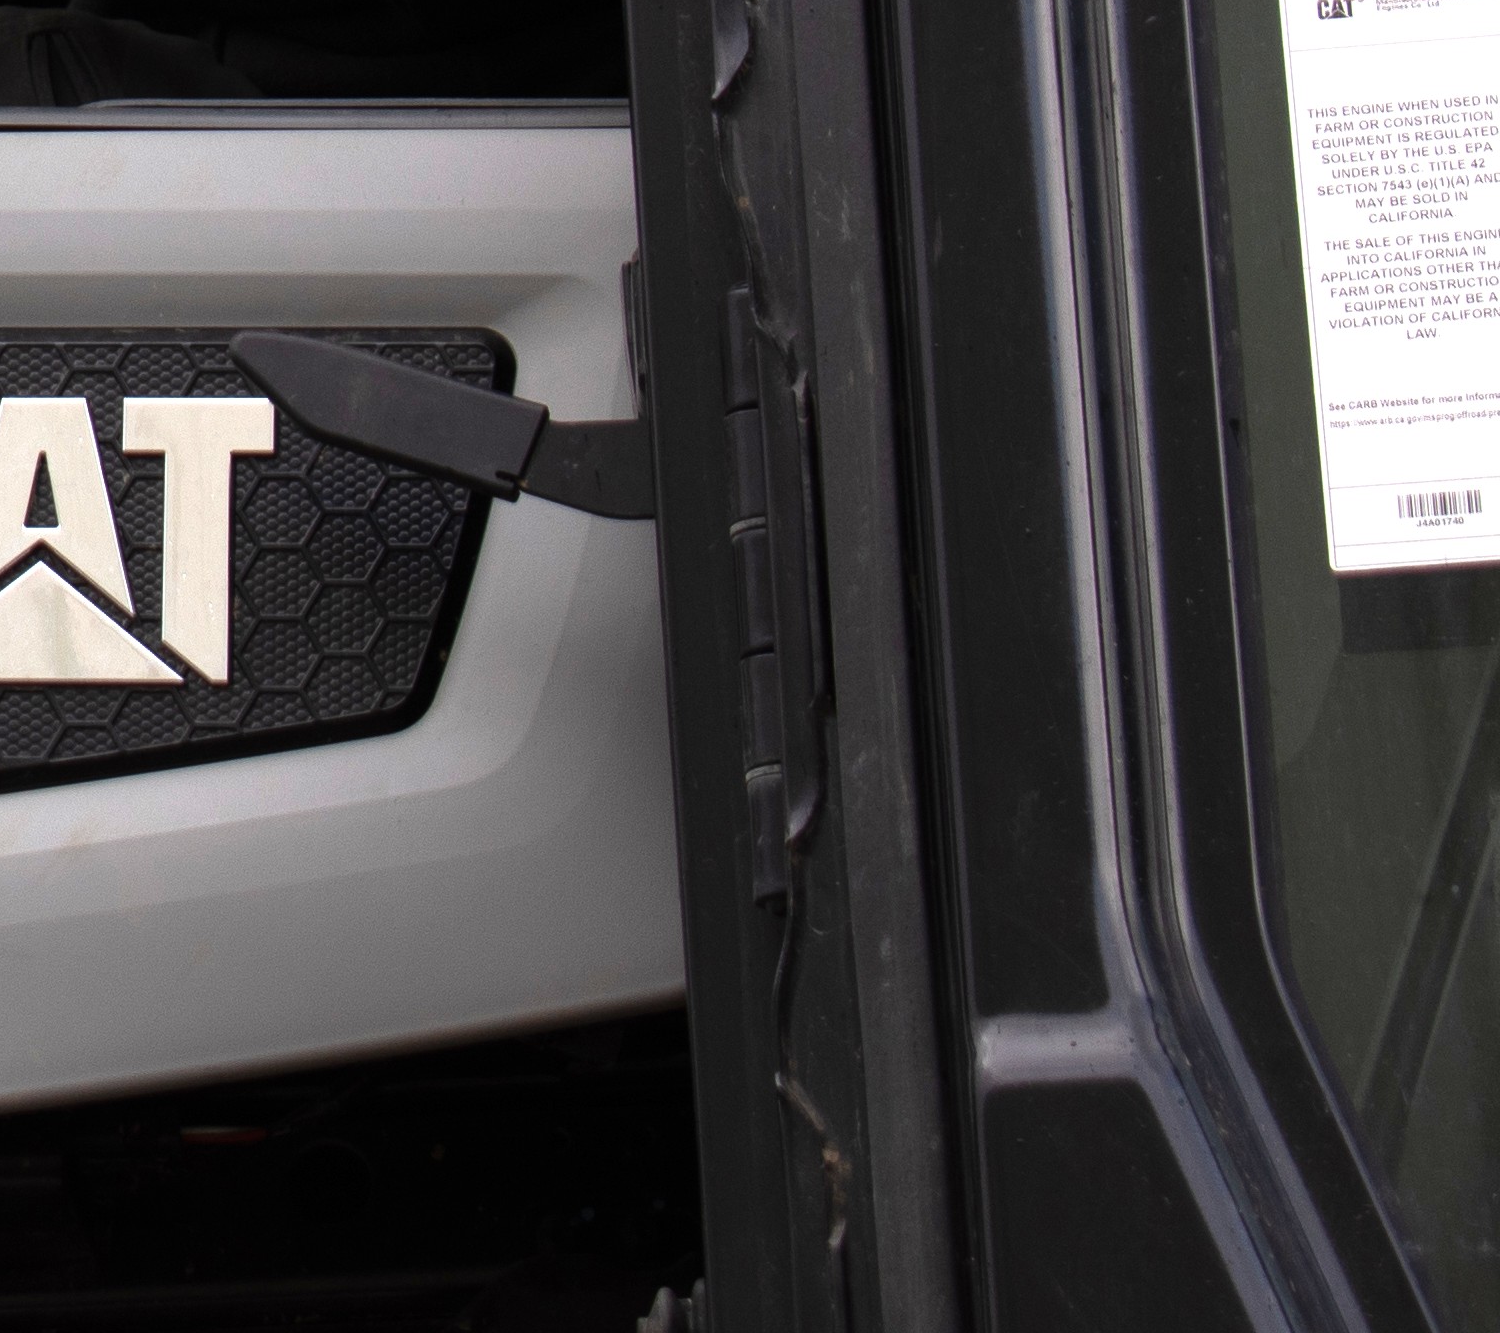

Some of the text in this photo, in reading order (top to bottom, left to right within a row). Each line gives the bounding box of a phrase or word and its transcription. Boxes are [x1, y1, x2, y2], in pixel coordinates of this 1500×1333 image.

[1308, 95, 1498, 118] THIS ENGINE WHEN USED IN
[1315, 111, 1493, 133] FARM OR CONSTRUCTION
[1312, 126, 1499, 149] EQUIPMENT IS REGULATED
[1322, 151, 1374, 164] SOLELY
[1381, 149, 1398, 160] BY
[1403, 147, 1429, 158] THE
[1466, 142, 1492, 153] EPA
[1332, 166, 1379, 179] UNDER
[1429, 159, 1465, 171] TITLE
[1471, 158, 1485, 168] 42
[1318, 182, 1377, 196] SECTION
[1382, 180, 1412, 191] 7543
[1355, 191, 1468, 208] MAY BE SOLD IN
[1324, 228, 1500, 251] THE SALE OF THIS ENGIN
[1347, 246, 1486, 265] INTO CALIFORNIA IN
[1321, 266, 1422, 283] APPLICATIONS
[1427, 262, 1474, 274] OTHER
[1330, 286, 1369, 298] FARM
[1375, 284, 1394, 294] OR
[1345, 292, 1498, 312] EQUIPMENT MAY BE A
[1329, 315, 1403, 329] VIOLATION
[1409, 313, 1426, 323] OF
